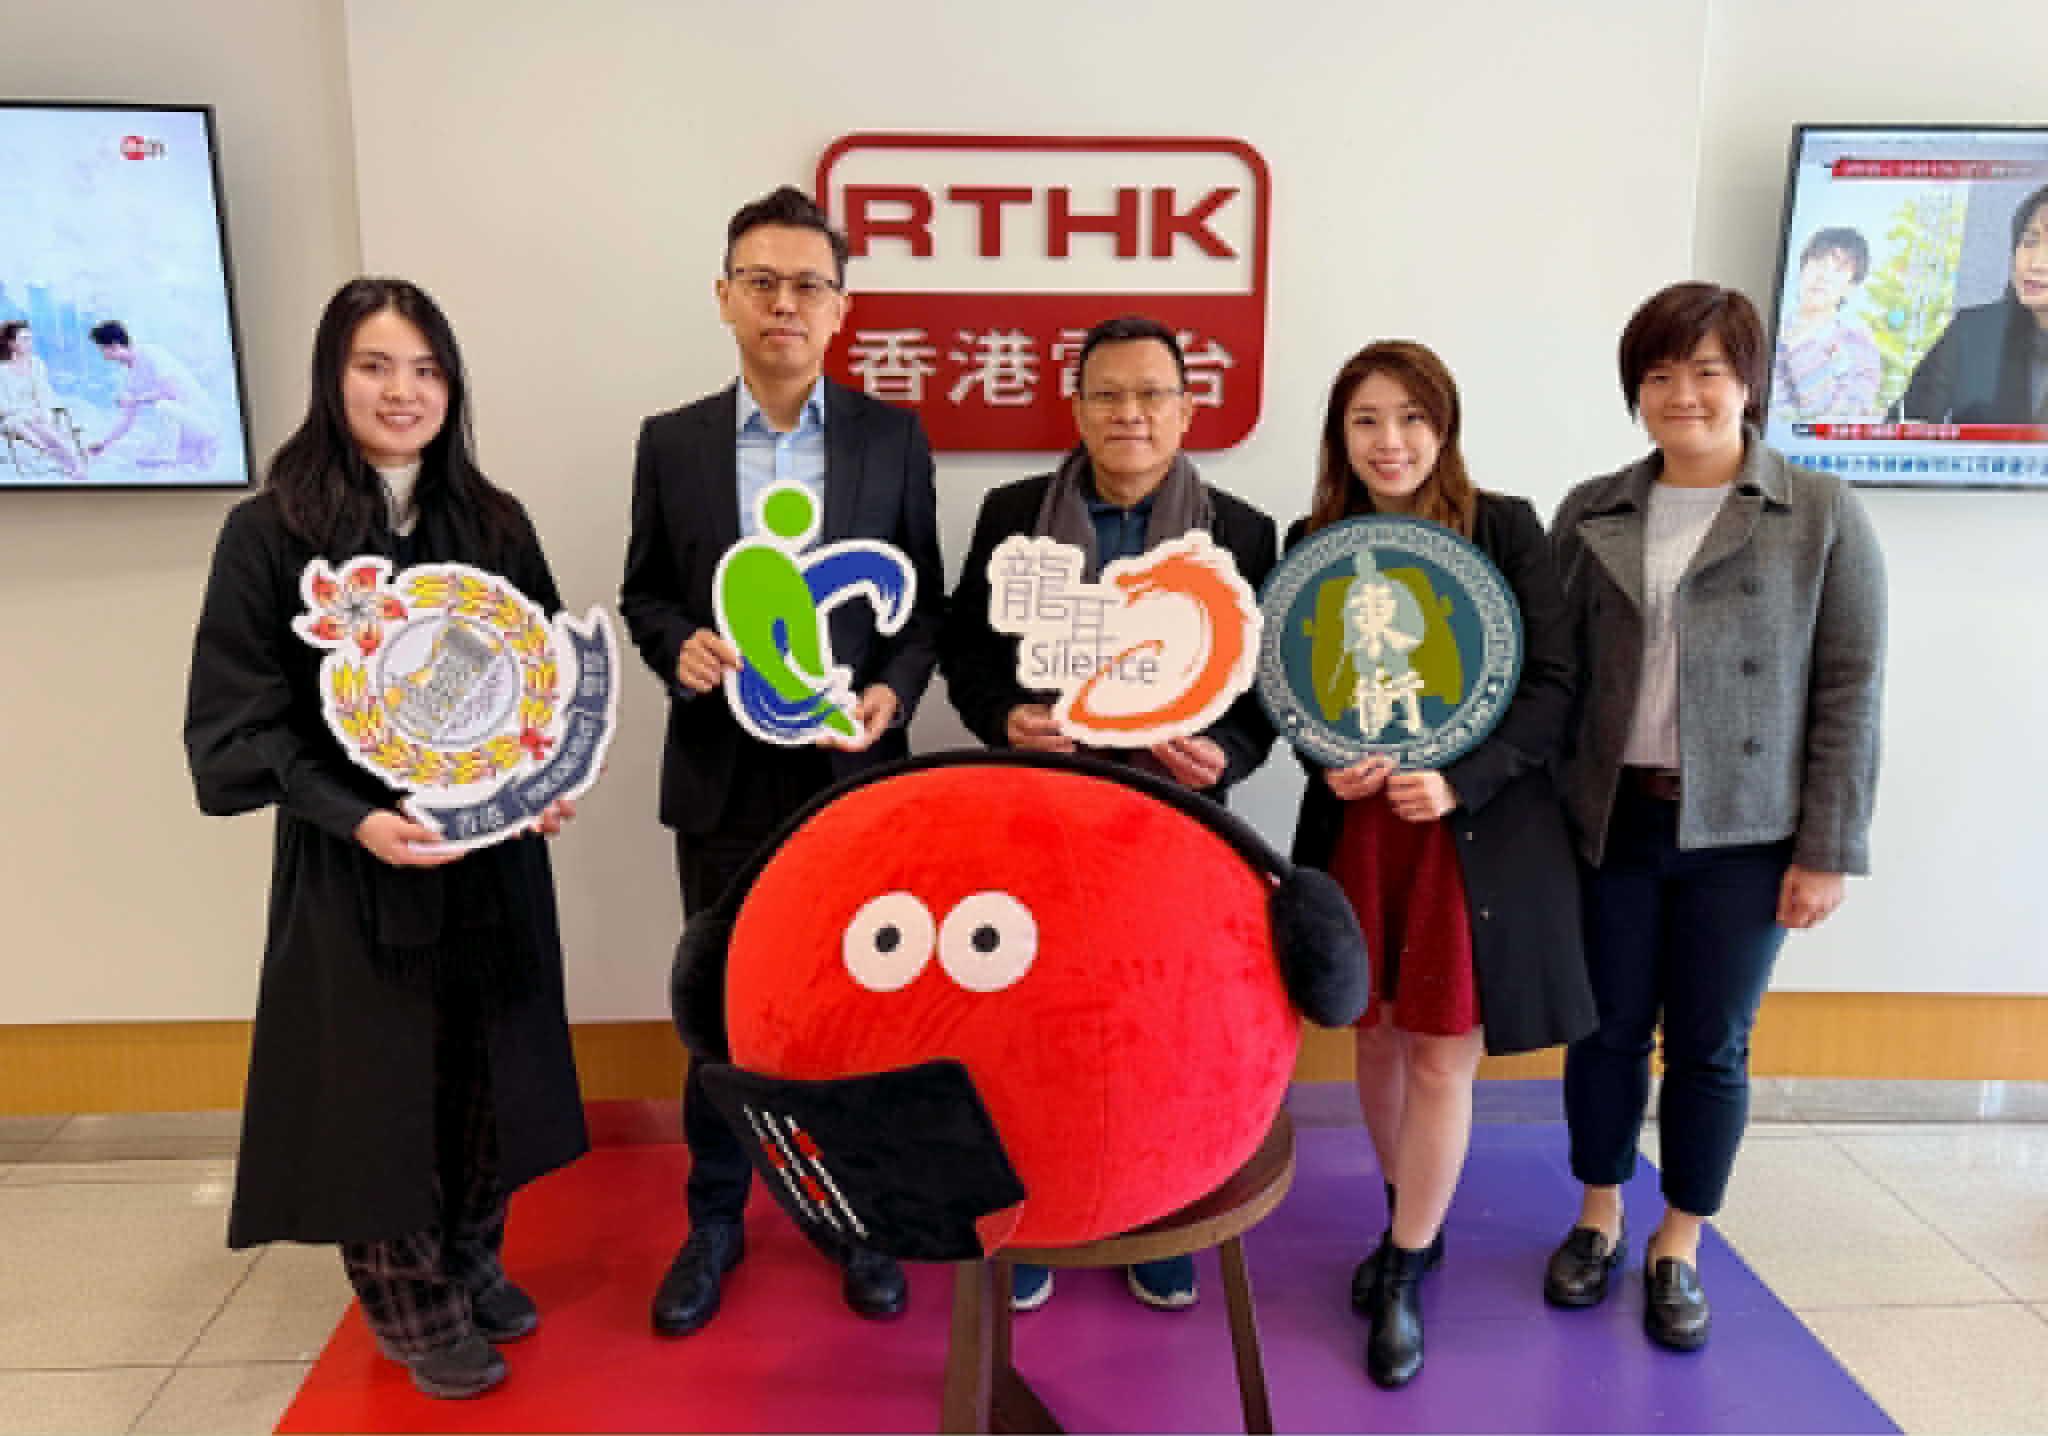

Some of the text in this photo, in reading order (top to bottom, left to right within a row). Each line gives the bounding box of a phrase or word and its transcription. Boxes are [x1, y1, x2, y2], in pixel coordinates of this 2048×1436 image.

[845, 184, 1240, 258] RTHK
[849, 328, 1237, 407] 香港台
[1000, 545, 1119, 658] 龍耳
[1031, 640, 1159, 684] Silence
